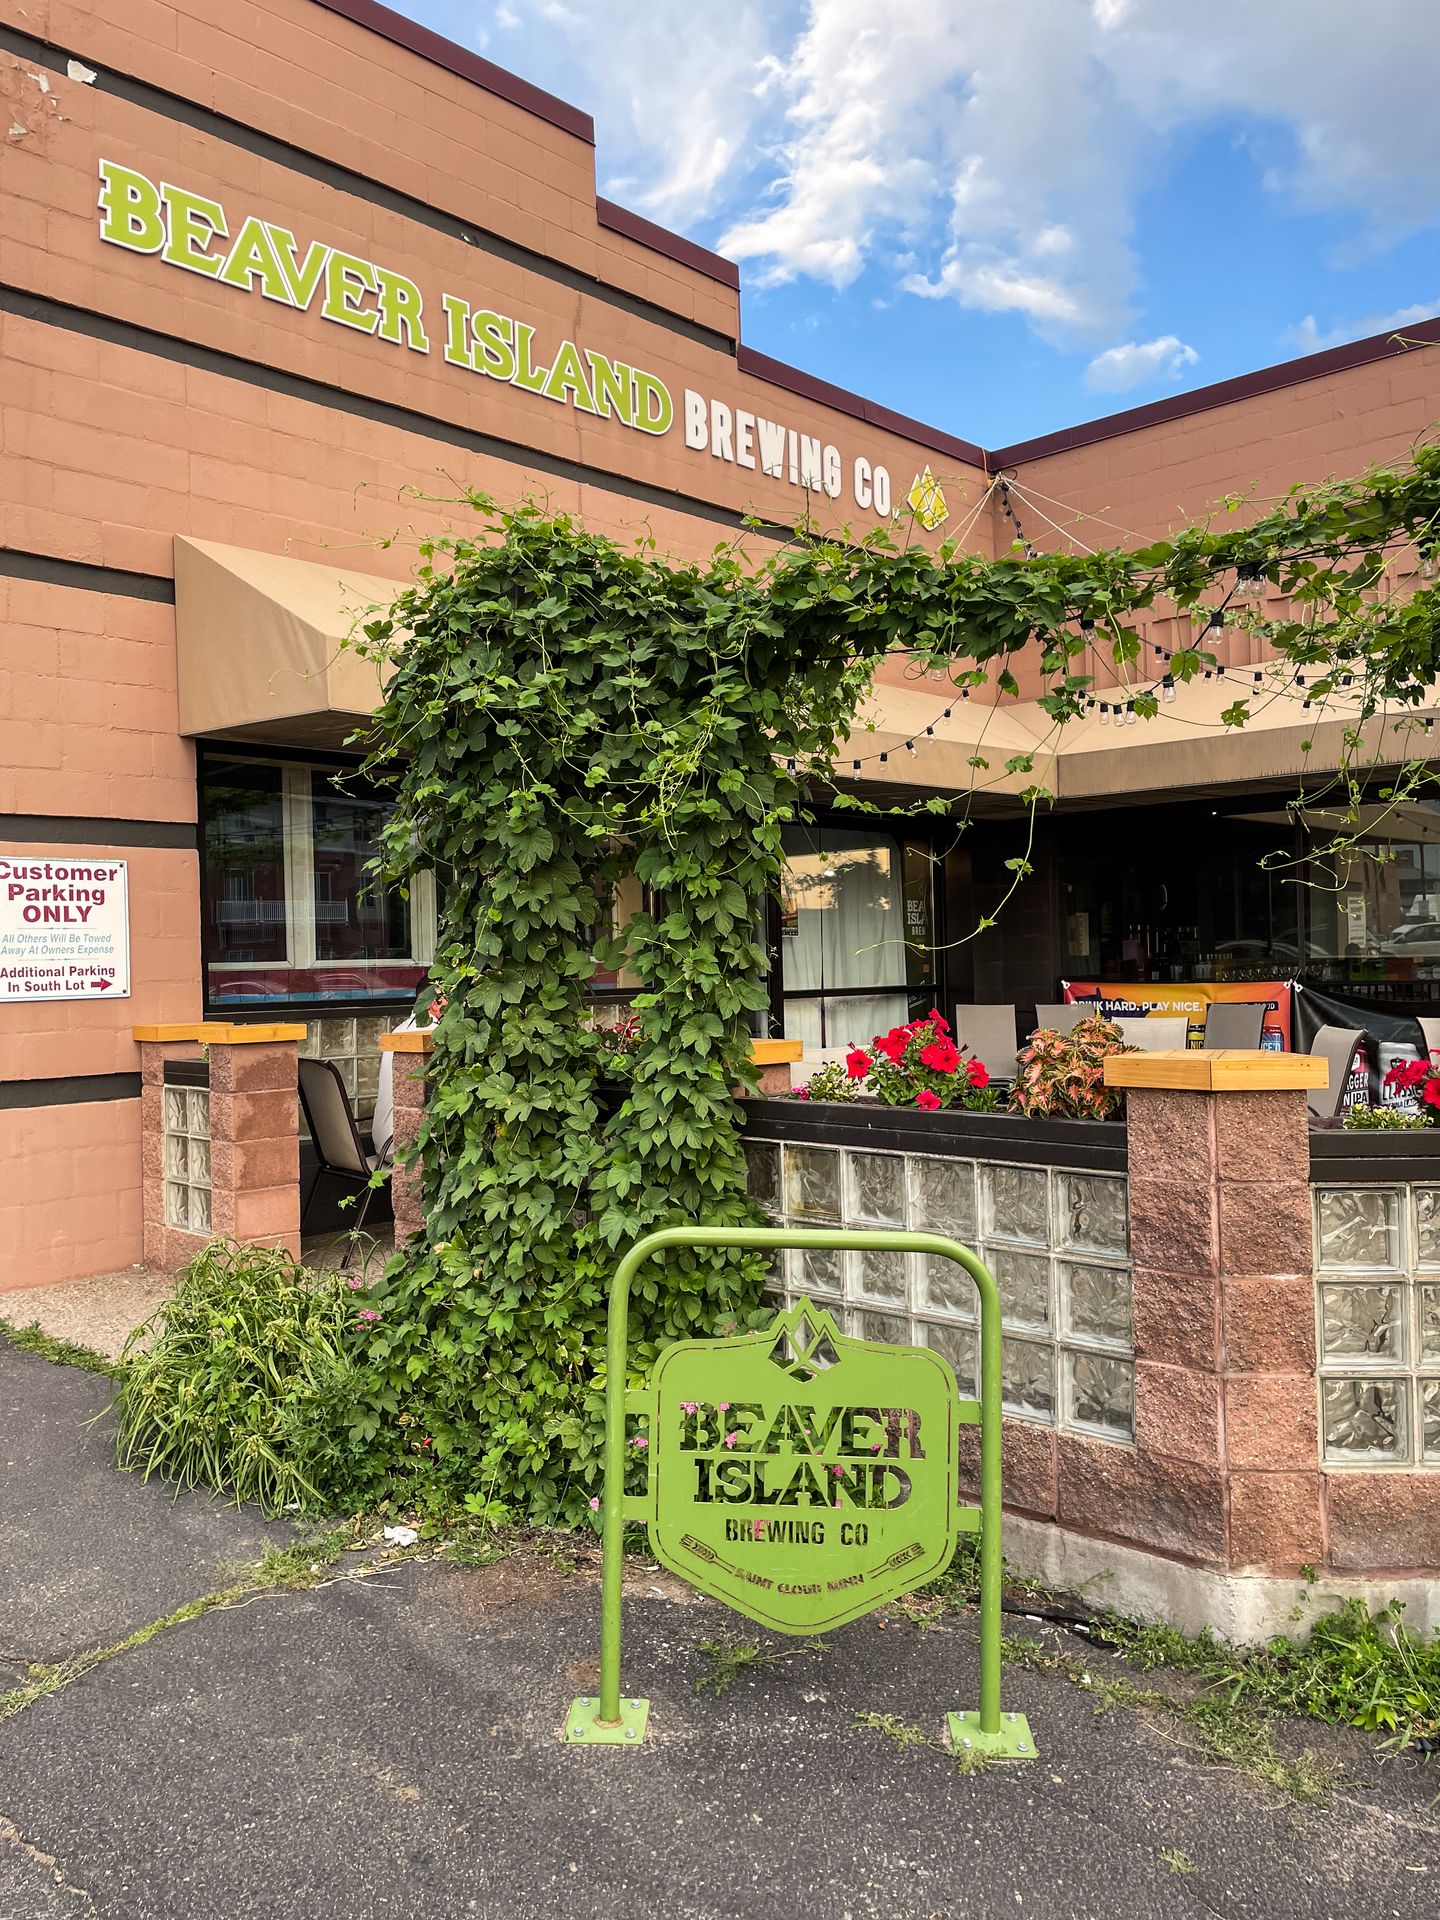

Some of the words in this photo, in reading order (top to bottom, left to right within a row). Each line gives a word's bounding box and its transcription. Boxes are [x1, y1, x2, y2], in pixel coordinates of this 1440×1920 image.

[98, 158, 429, 354] BEAVER
[443, 293, 673, 436] ISLAND
[684, 389, 842, 498] BREWING
[0, 861, 117, 881] Customer
[8, 884, 105, 905] Parking
[23, 905, 92, 923] ONLY
[2, 934, 14, 943] All
[17, 933, 47, 943] Others
[50, 933, 66, 943] Will
[69, 933, 80, 943] Be
[83, 933, 112, 943] Towed
[0, 945, 26, 957] Away
[28, 945, 39, 955] At
[41, 945, 74, 954] Owners
[77, 945, 114, 956] Expense
[0, 966, 65, 978] Additional
[69, 965, 115, 978] Parking
[8, 982, 19, 992] In
[24, 980, 61, 992] South
[65, 980, 85, 991] Lot
[1106, 1001, 1140, 1011] HARD.
[1142, 1001, 1170, 1011] PLAY
[1172, 1002, 1203, 1012] NICE.
[679, 1401, 926, 1460] BEAVER
[693, 1458, 912, 1511] ISLAND
[725, 1518, 825, 1546] BREWING
[840, 1522, 869, 1547] CO
[734, 1567, 774, 1590] SAINT
[777, 1583, 822, 1595] CLOUD
